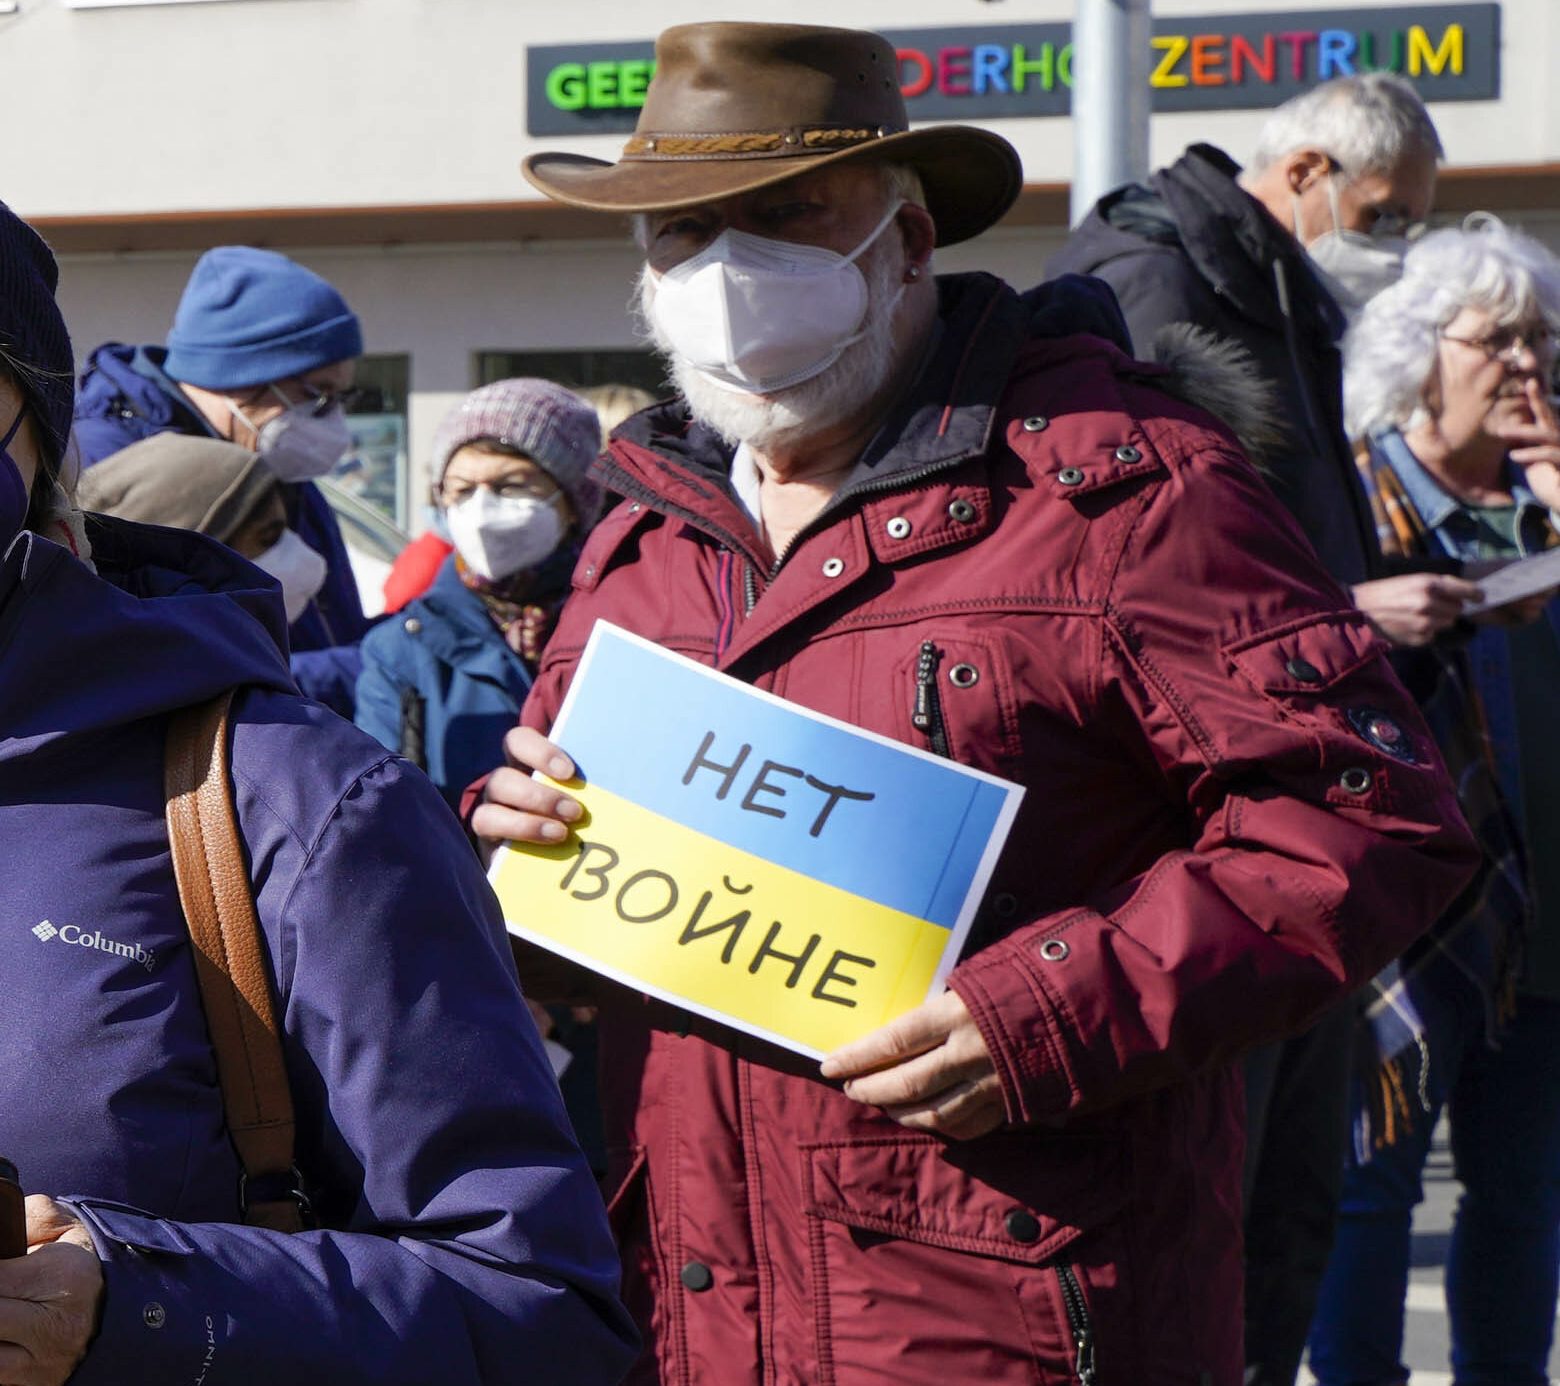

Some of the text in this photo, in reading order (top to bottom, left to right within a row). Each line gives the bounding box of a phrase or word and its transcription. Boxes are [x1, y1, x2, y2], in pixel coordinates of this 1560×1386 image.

[1149, 24, 1464, 88] ZENTRUM
[682, 731, 876, 838] НЕТ
[59, 924, 156, 973] Columbia
[559, 841, 877, 1009] ВОЙНЕ
